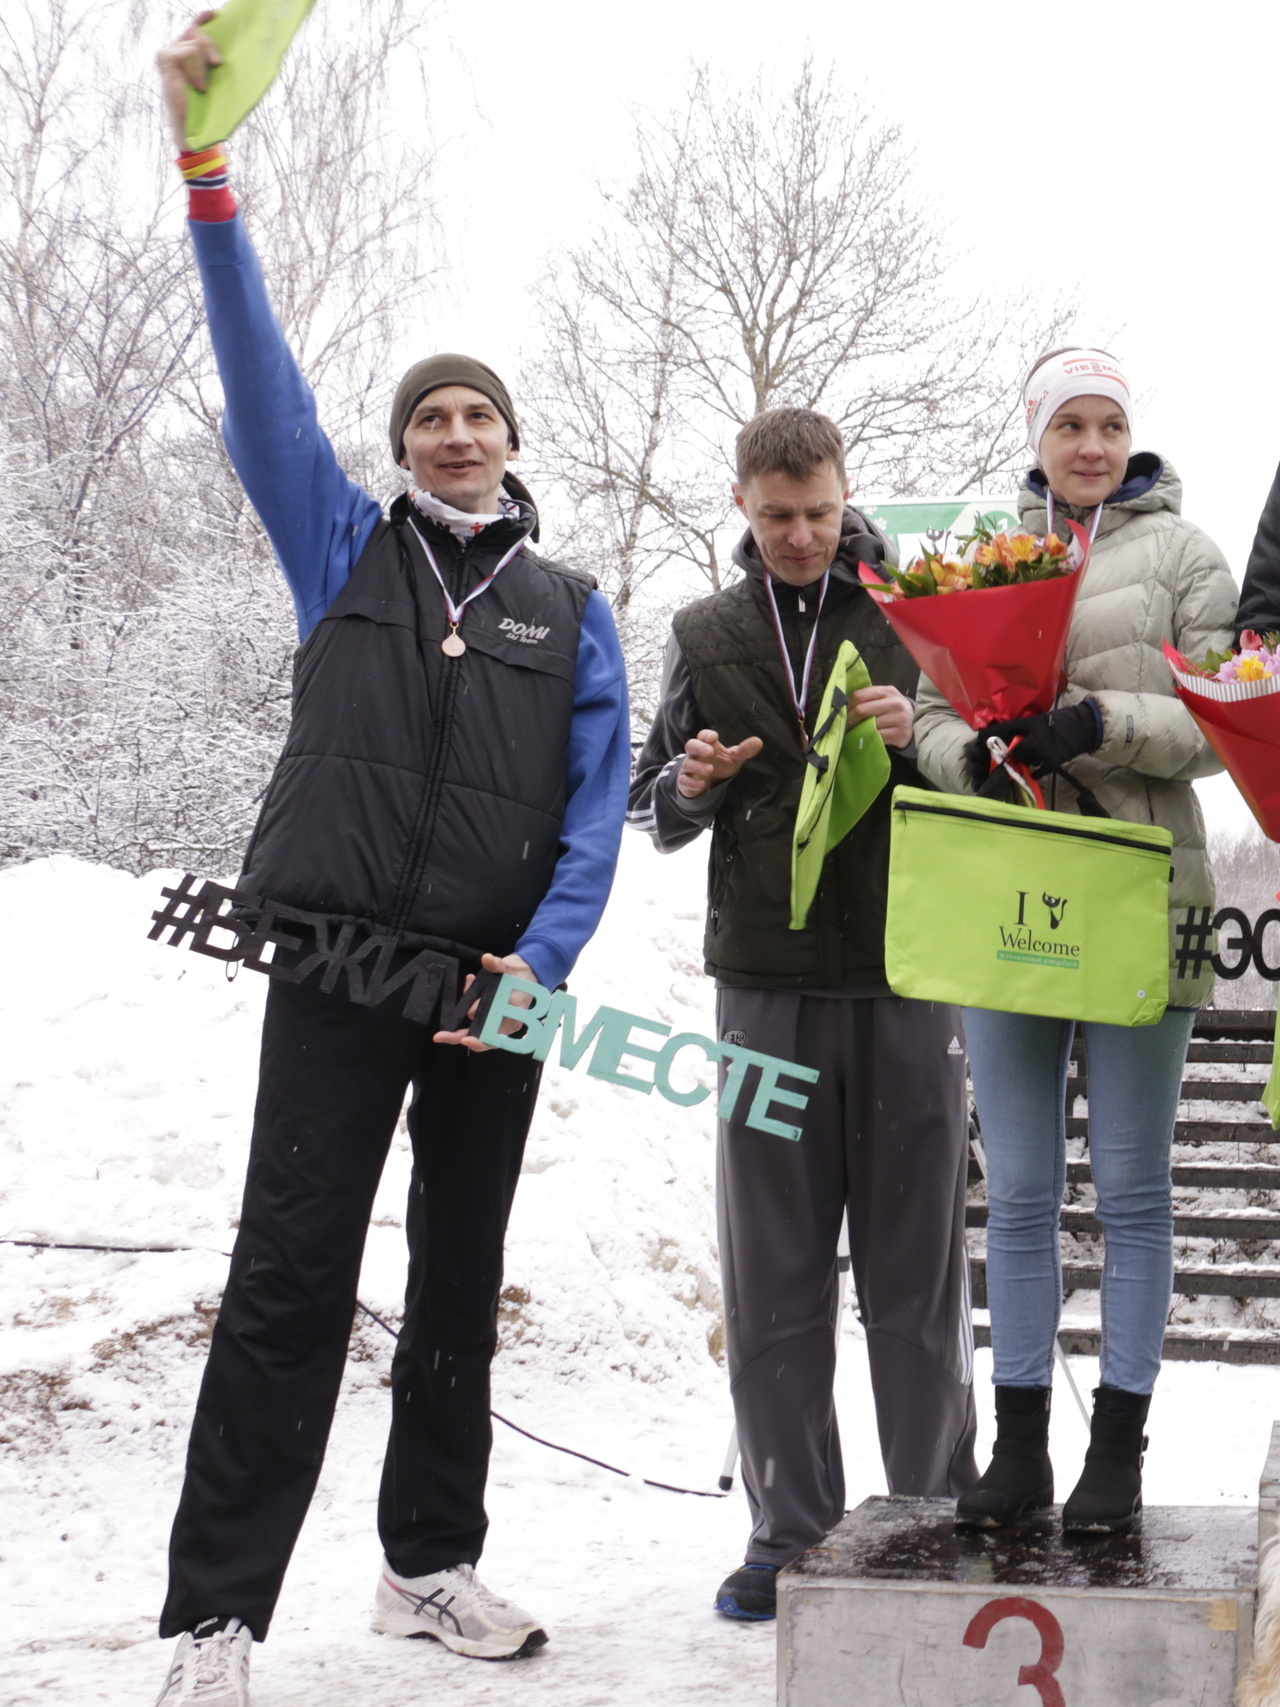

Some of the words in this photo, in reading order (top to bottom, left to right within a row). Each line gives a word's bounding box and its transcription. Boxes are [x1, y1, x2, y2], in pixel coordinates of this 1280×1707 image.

[498, 617, 551, 640] DOMI
[1013, 890, 1030, 927] I
[999, 925, 1080, 957] Welcome
[962, 1596, 1066, 1707] 3
